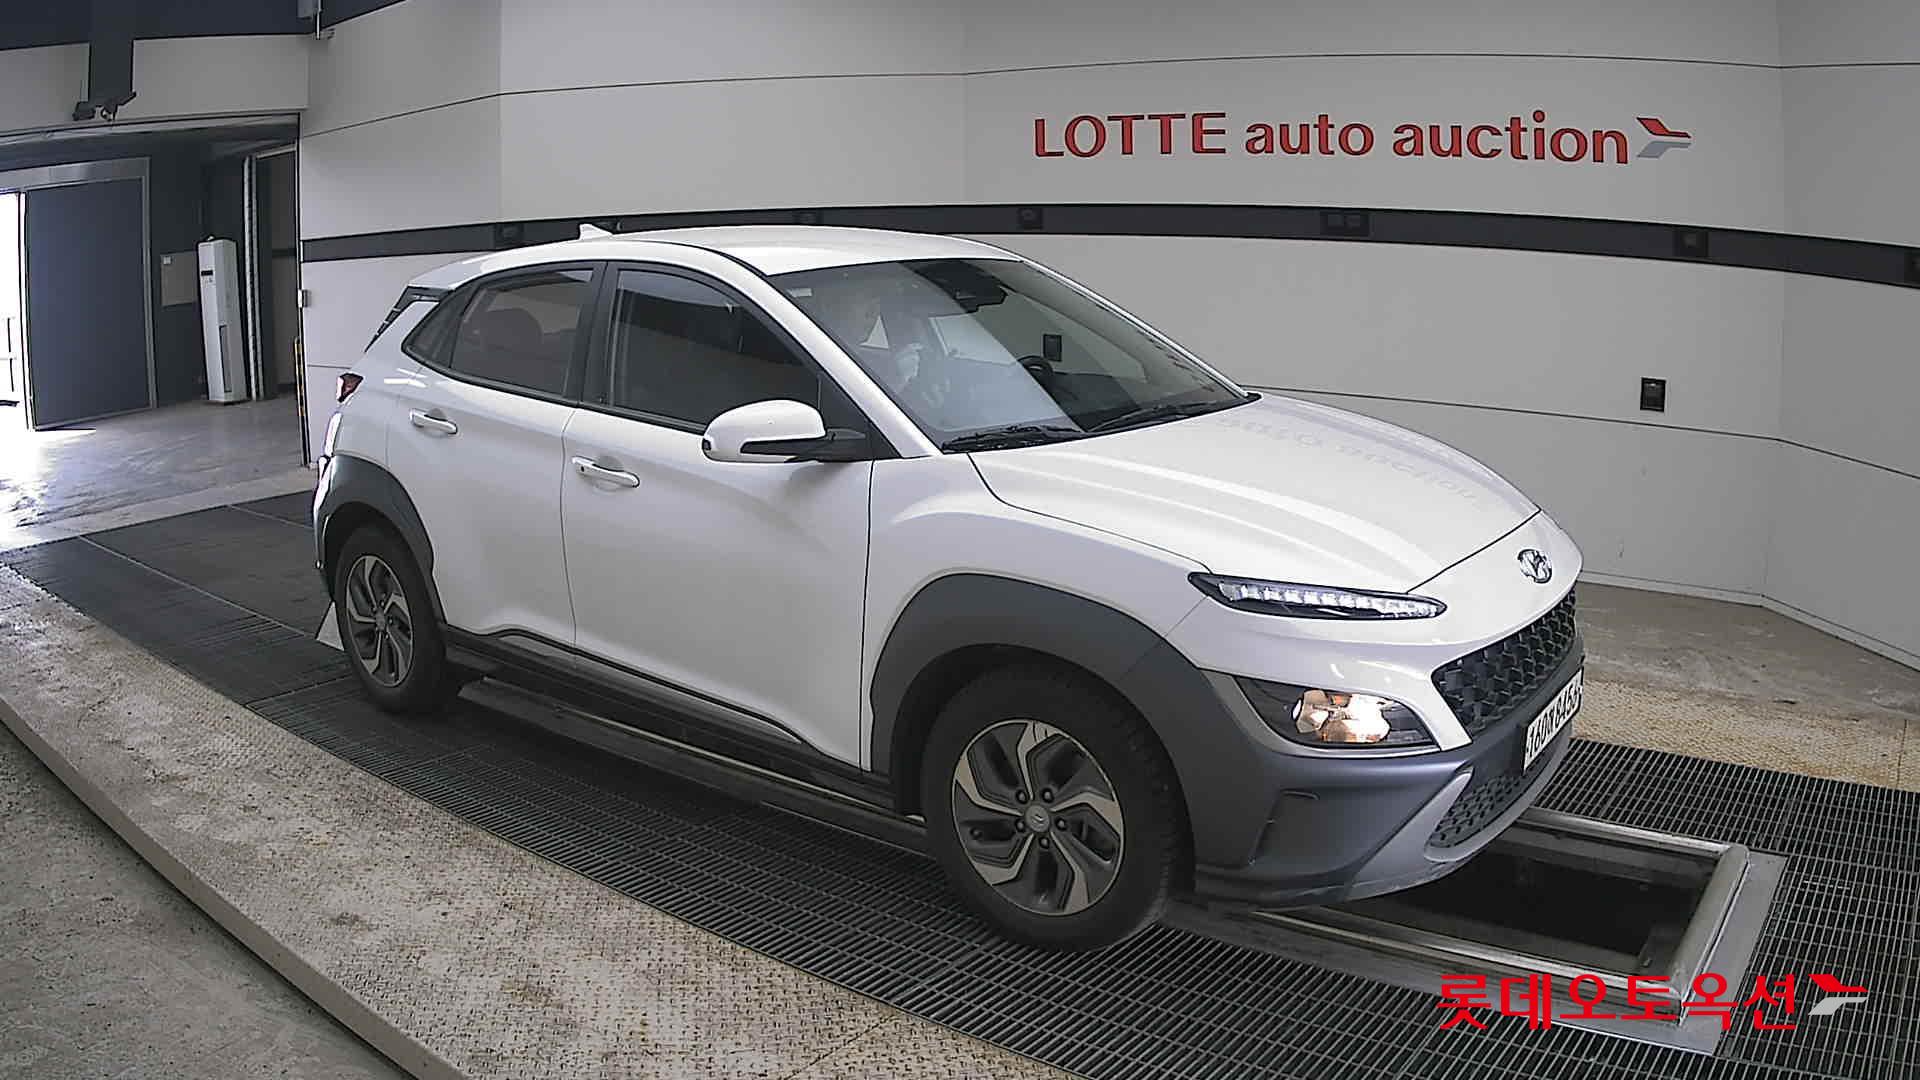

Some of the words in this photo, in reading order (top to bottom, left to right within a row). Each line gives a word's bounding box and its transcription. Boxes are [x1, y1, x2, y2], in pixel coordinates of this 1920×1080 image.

[1035, 113, 1227, 157] LOTTE
[1245, 114, 1375, 156] auto
[1392, 110, 1629, 164] auction
